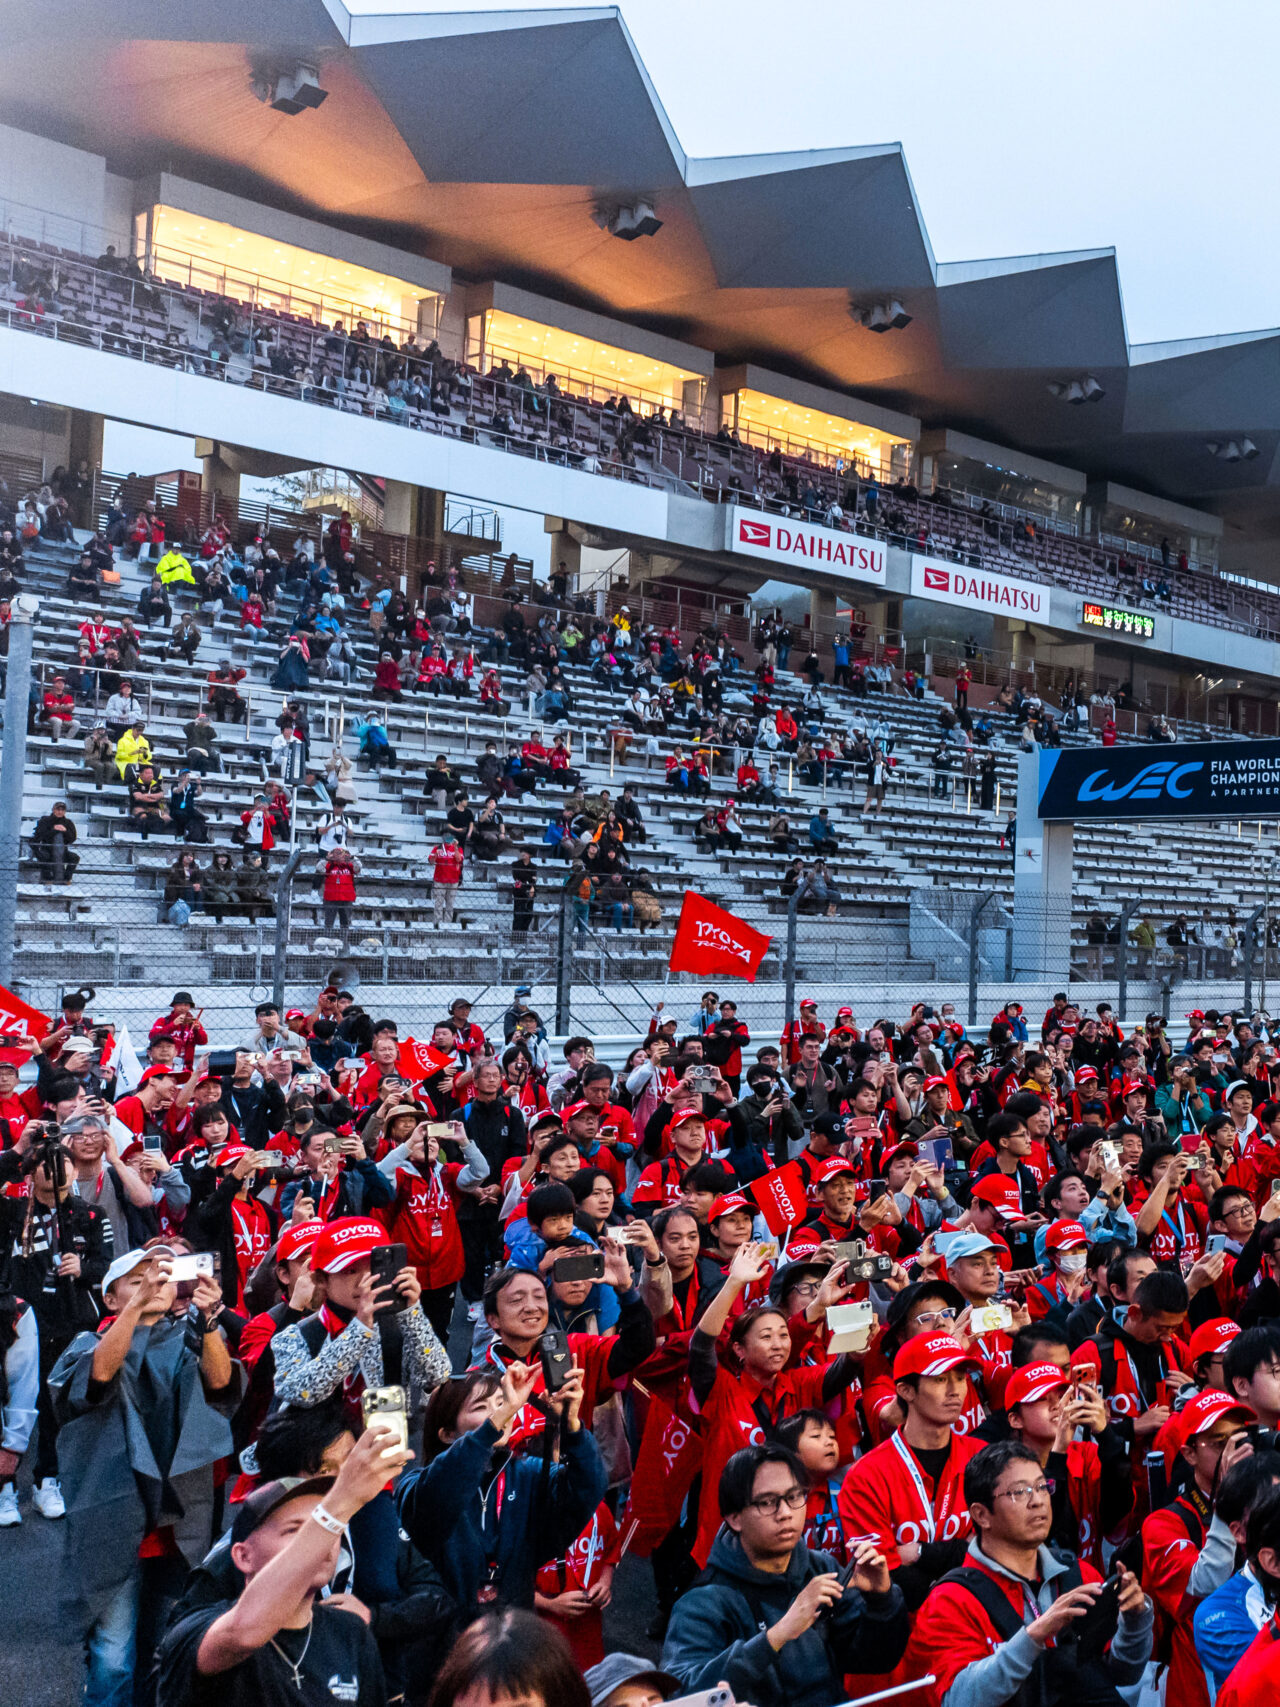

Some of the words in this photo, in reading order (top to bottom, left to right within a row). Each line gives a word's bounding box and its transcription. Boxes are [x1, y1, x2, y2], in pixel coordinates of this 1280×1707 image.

[776, 528, 883, 574] DAIHATSU
[954, 574, 1041, 613] DAIHATSU
[1077, 761, 1204, 802] WEC
[1211, 760, 1231, 772] FIA
[772, 1176, 796, 1221] TOYOTA
[331, 1224, 381, 1240] TOYOTA
[940, 1493, 950, 1520] TOYOTA
[1191, 1490, 1208, 1515] PENTAX
